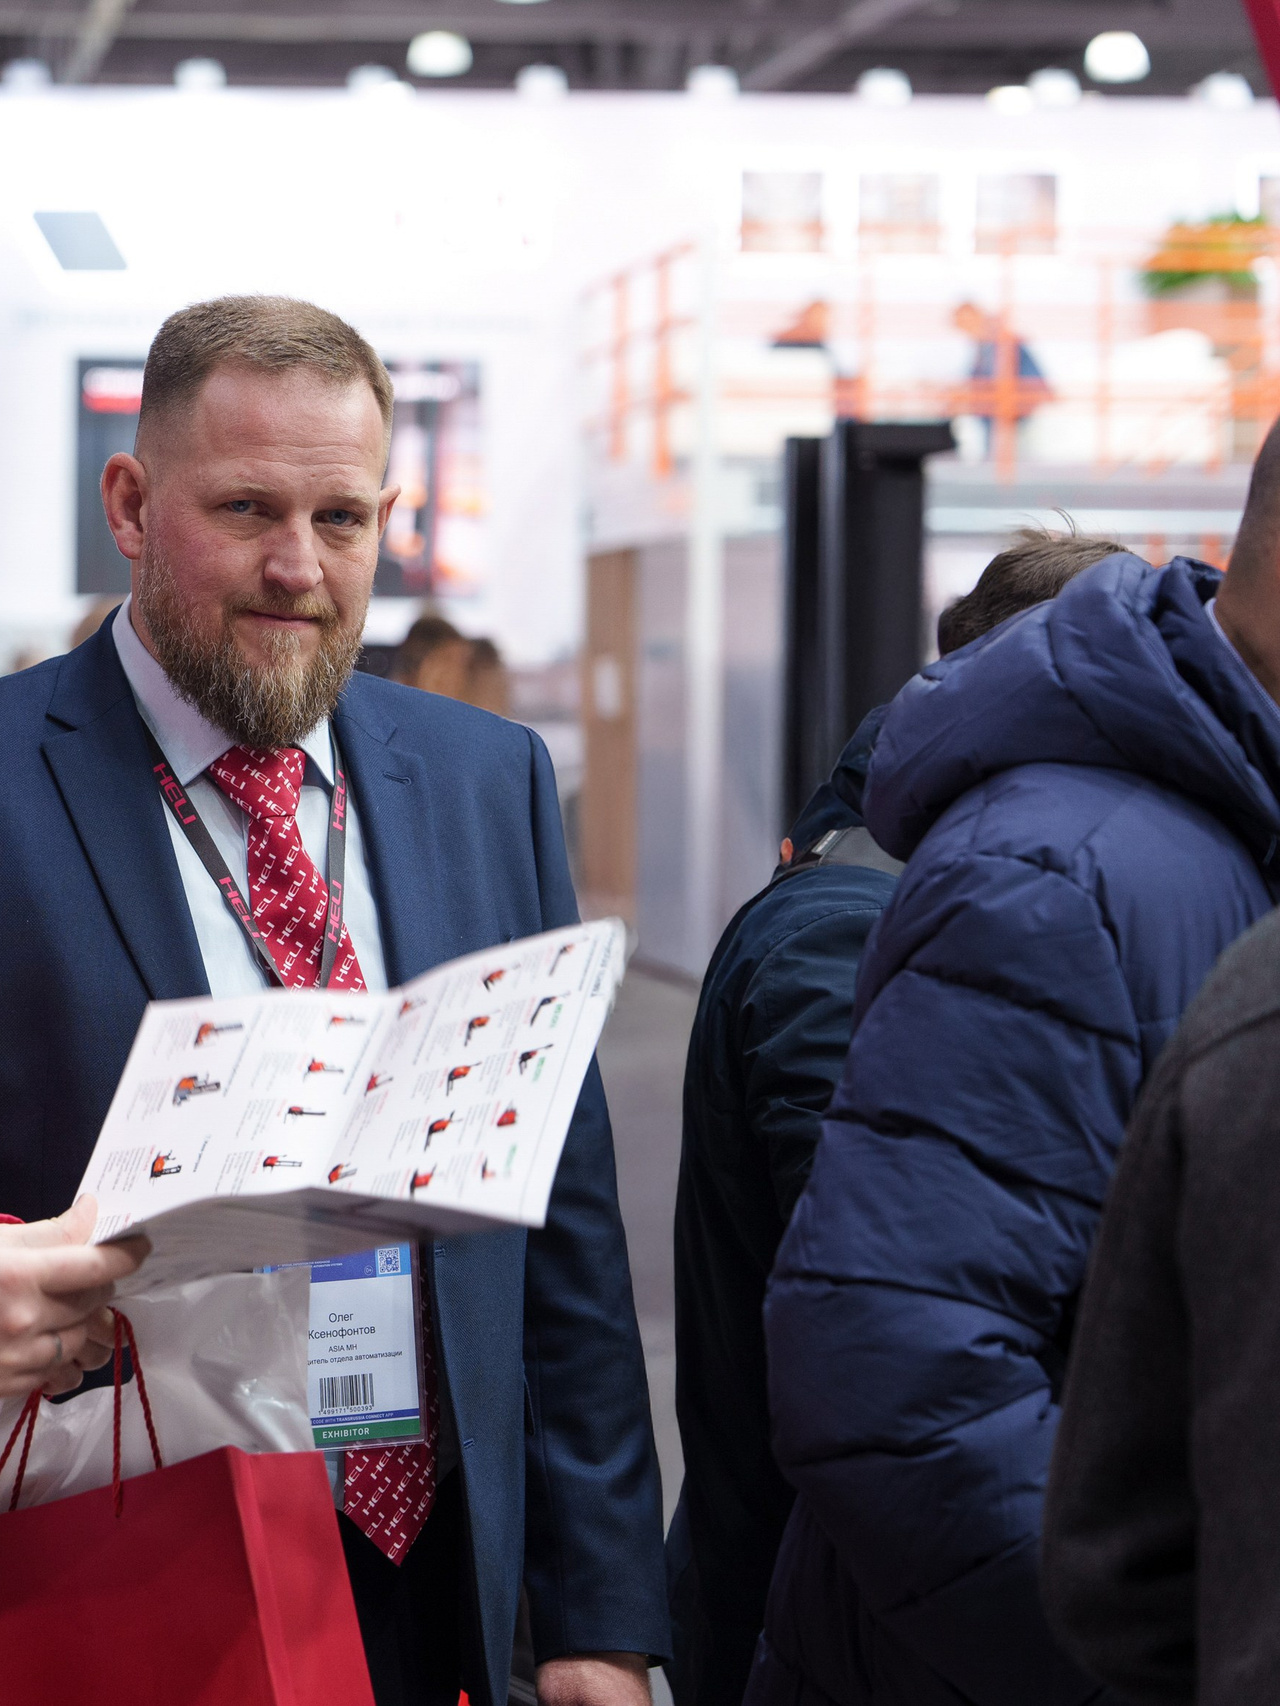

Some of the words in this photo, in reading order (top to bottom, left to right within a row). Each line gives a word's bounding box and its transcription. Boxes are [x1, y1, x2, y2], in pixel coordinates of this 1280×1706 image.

[210, 763, 246, 790] HELI
[242, 763, 281, 793] HELI
[153, 762, 197, 825] HELI
[229, 792, 262, 820] HELI
[333, 769, 346, 832] HELI
[254, 818, 274, 857] HELI
[252, 853, 277, 892] HELI
[280, 869, 307, 910] HELI
[219, 876, 261, 938] HELI
[308, 890, 328, 929] HELI
[327, 879, 342, 944] HELI
[276, 905, 307, 946] HELI
[280, 941, 304, 977] HELI
[335, 953, 356, 983] HEL
[291, 974, 306, 994] ELI
[308, 1325, 376, 1340] Ксенофонтов
[328, 1312, 354, 1323] Олег
[328, 1345, 345, 1353] ASIA
[346, 1343, 358, 1351] MH
[329, 1355, 354, 1364] отдела
[354, 1350, 403, 1361] автоматизации
[336, 1415, 365, 1423] TRANSRUSSIA
[349, 1405, 373, 1413] 500393
[322, 1427, 370, 1439] EXHIBITOR
[370, 1445, 397, 1480] HEL
[362, 1476, 391, 1516] HELI
[392, 1461, 419, 1501] HELI
[343, 1491, 363, 1516] ELI
[384, 1497, 412, 1536] HELI
[413, 1480, 436, 1521] HELI
[365, 1511, 385, 1539] ELI
[387, 1532, 407, 1560] ELI
